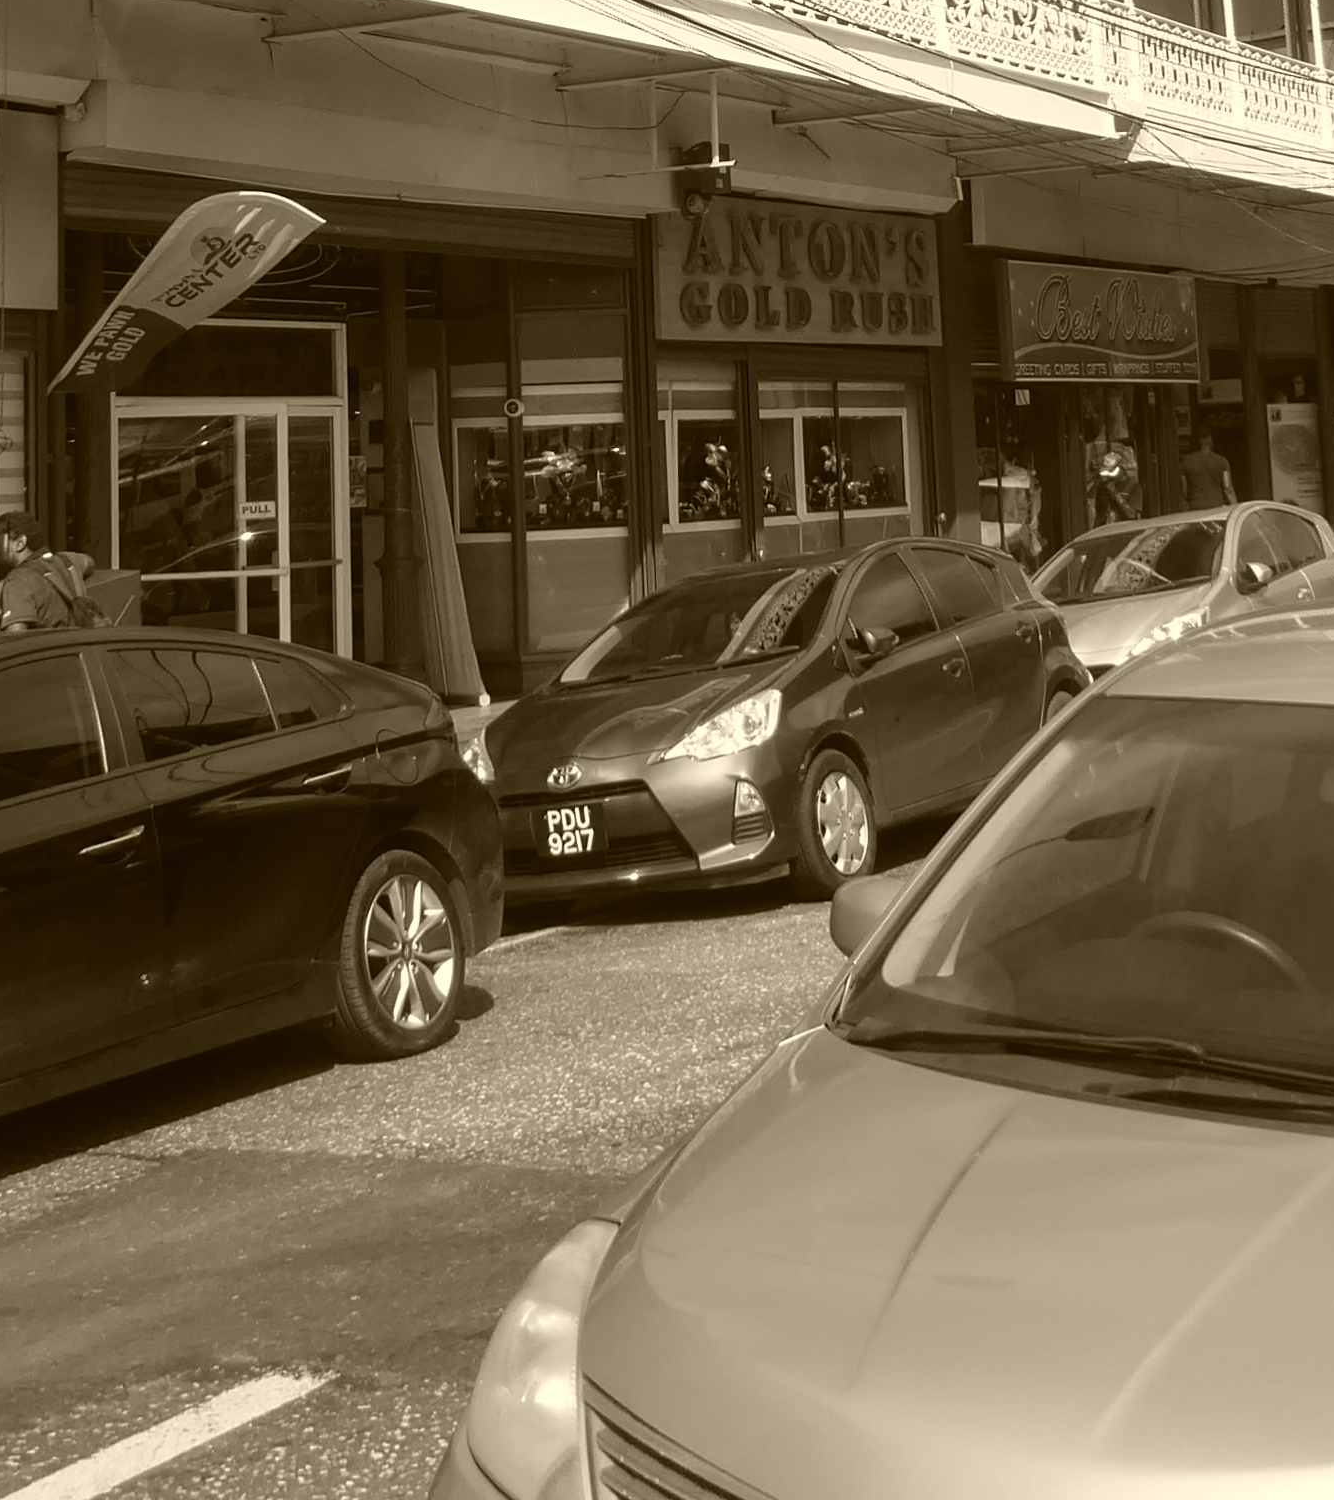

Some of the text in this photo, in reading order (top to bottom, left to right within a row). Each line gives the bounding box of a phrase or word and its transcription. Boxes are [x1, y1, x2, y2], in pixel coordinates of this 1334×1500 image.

[248, 243, 267, 262] LTD
[680, 209, 934, 289] ANTON'S
[163, 232, 263, 309] CENTER
[678, 281, 938, 334] GOLD RUSH
[1034, 272, 1178, 344] Best Wishes
[76, 309, 137, 376] WE PAWN
[105, 326, 146, 361] GOLD
[1014, 363, 1052, 376] GREETING
[1054, 363, 1080, 376] CARDS
[1086, 364, 1107, 376] GIFTS
[240, 503, 272, 516] PULL
[546, 805, 591, 833] PDU
[546, 827, 596, 856] 9217
